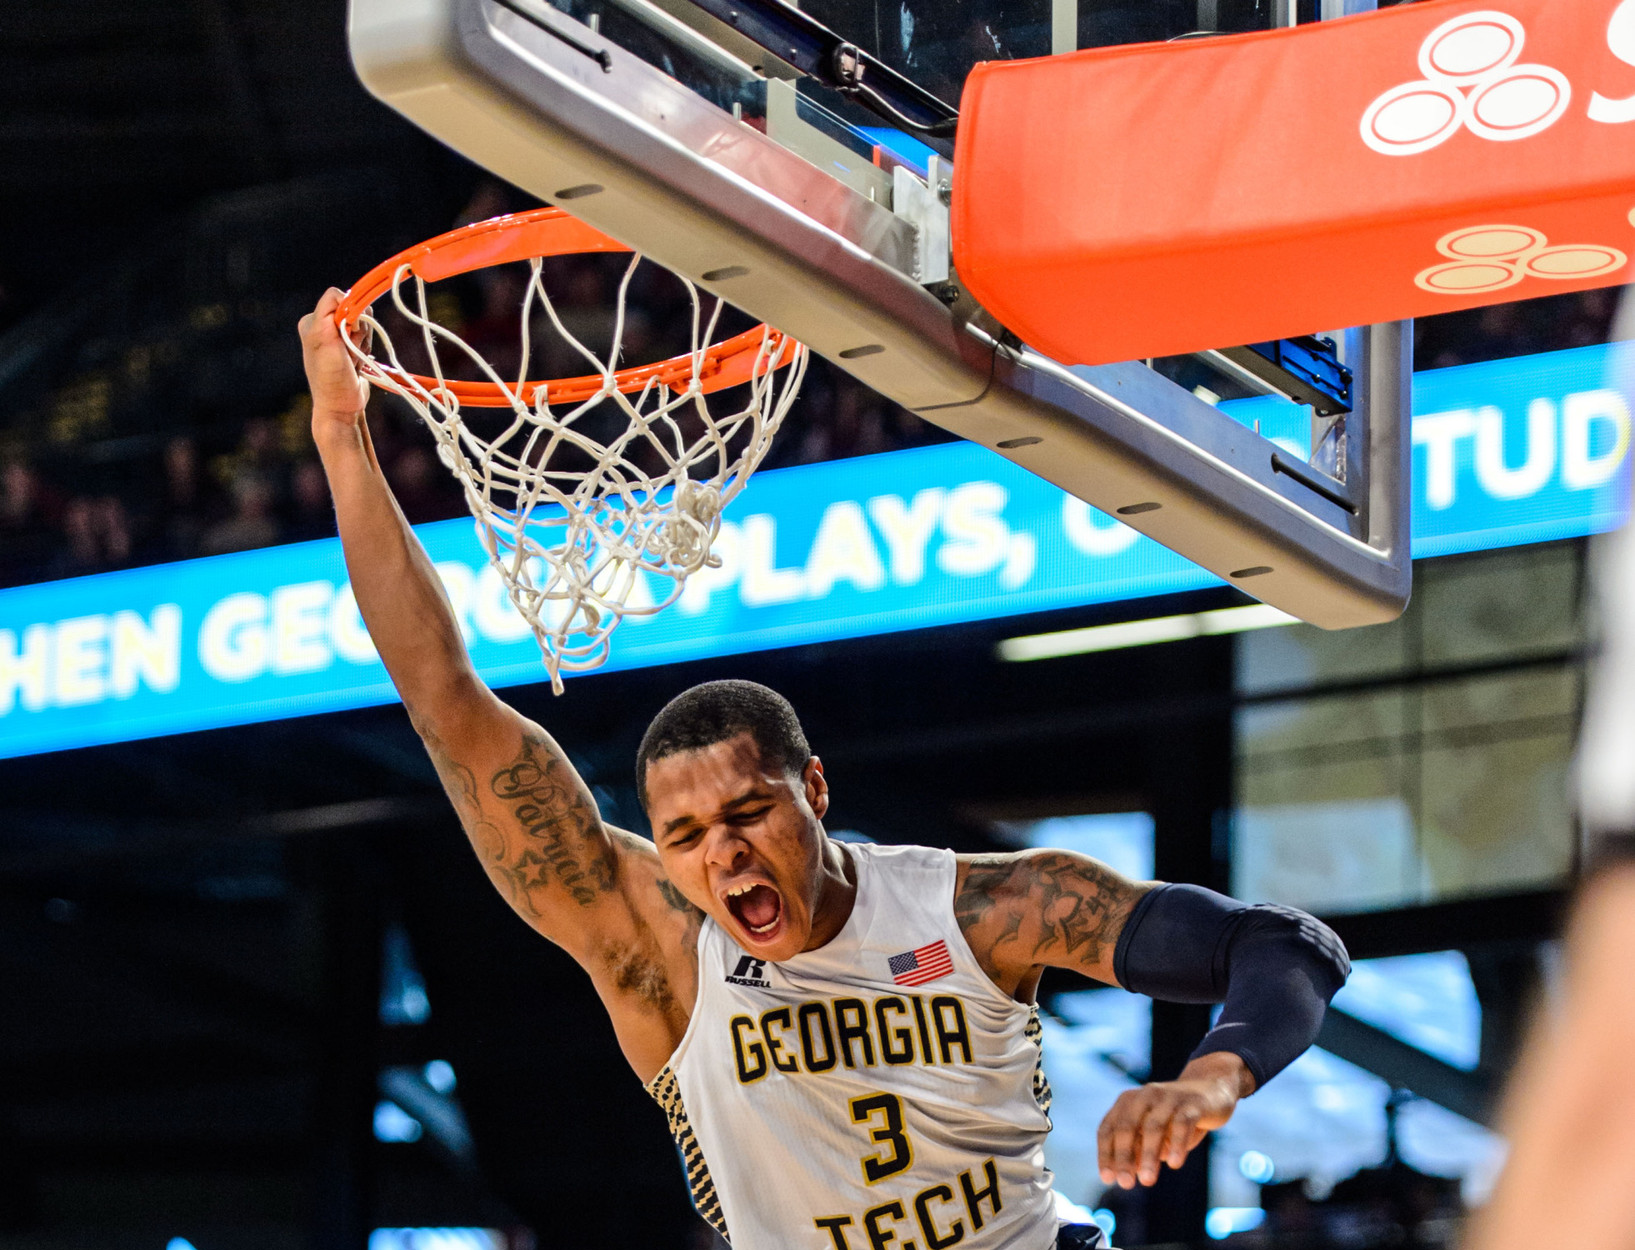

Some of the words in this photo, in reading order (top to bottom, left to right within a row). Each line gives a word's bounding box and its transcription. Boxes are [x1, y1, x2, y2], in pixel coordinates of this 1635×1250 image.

[0, 603, 182, 716] HEN
[725, 975, 771, 988] RUSSELL
[730, 996, 974, 1086] GEORGIA
[848, 1092, 914, 1187] 3
